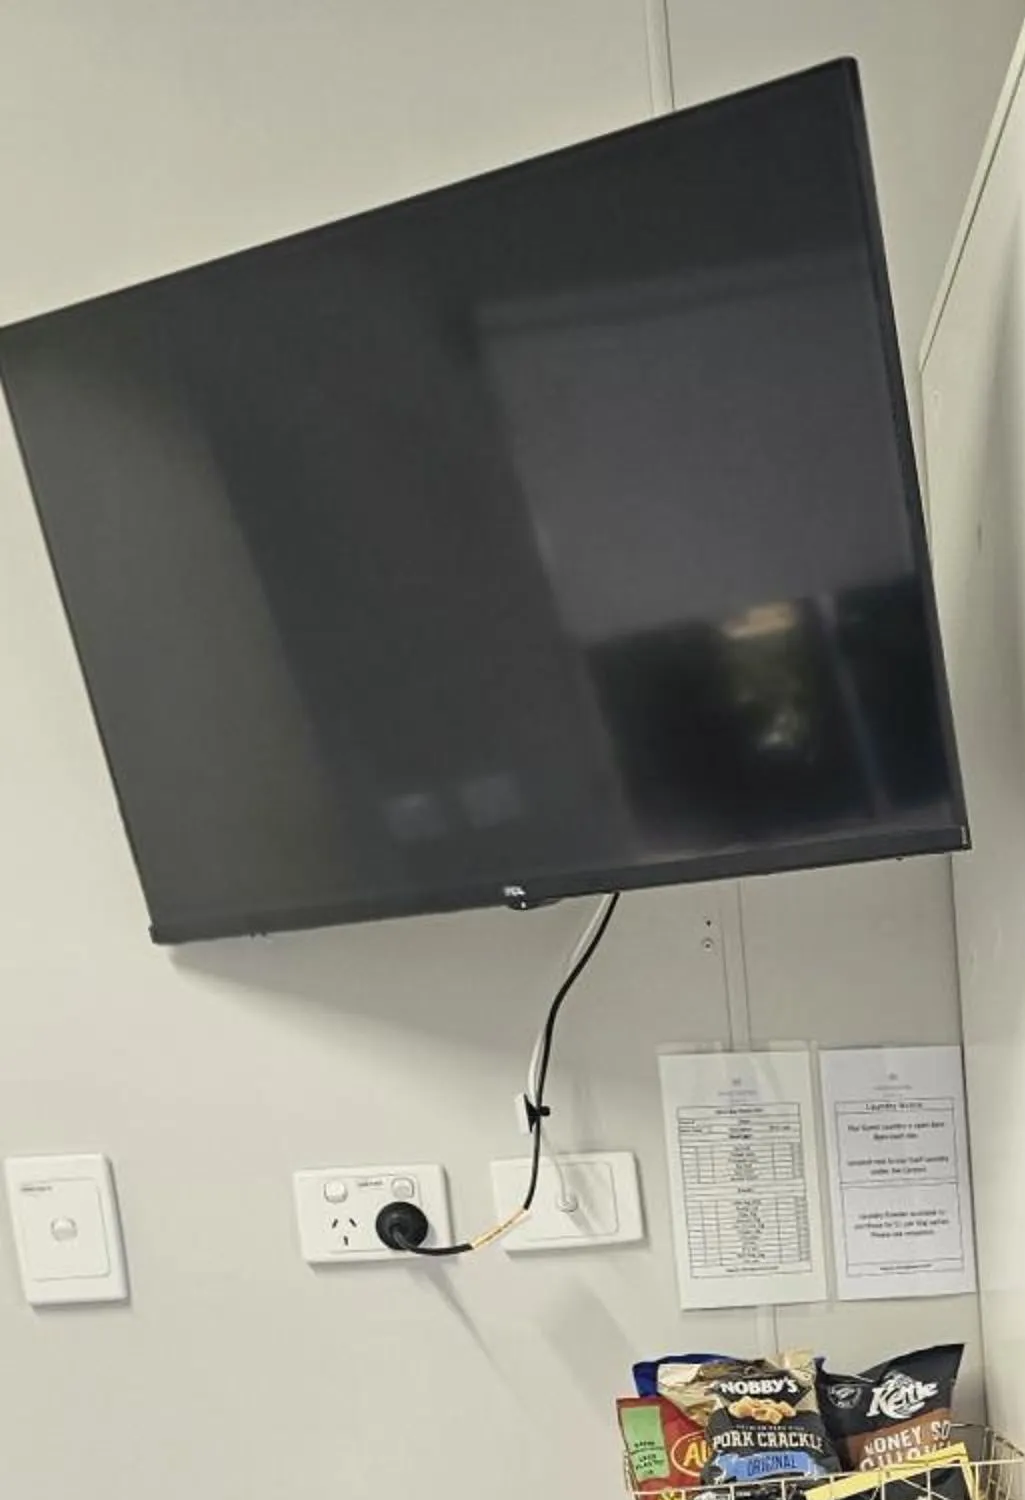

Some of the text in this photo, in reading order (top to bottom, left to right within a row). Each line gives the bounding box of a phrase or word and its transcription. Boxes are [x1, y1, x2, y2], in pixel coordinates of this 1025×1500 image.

[720, 1376, 800, 1395] NOBBY'S
[866, 1380, 939, 1419] Kettle
[712, 1430, 755, 1448] PORK
[930, 1418, 951, 1441] SO
[746, 1451, 798, 1476] ORIGINAL
